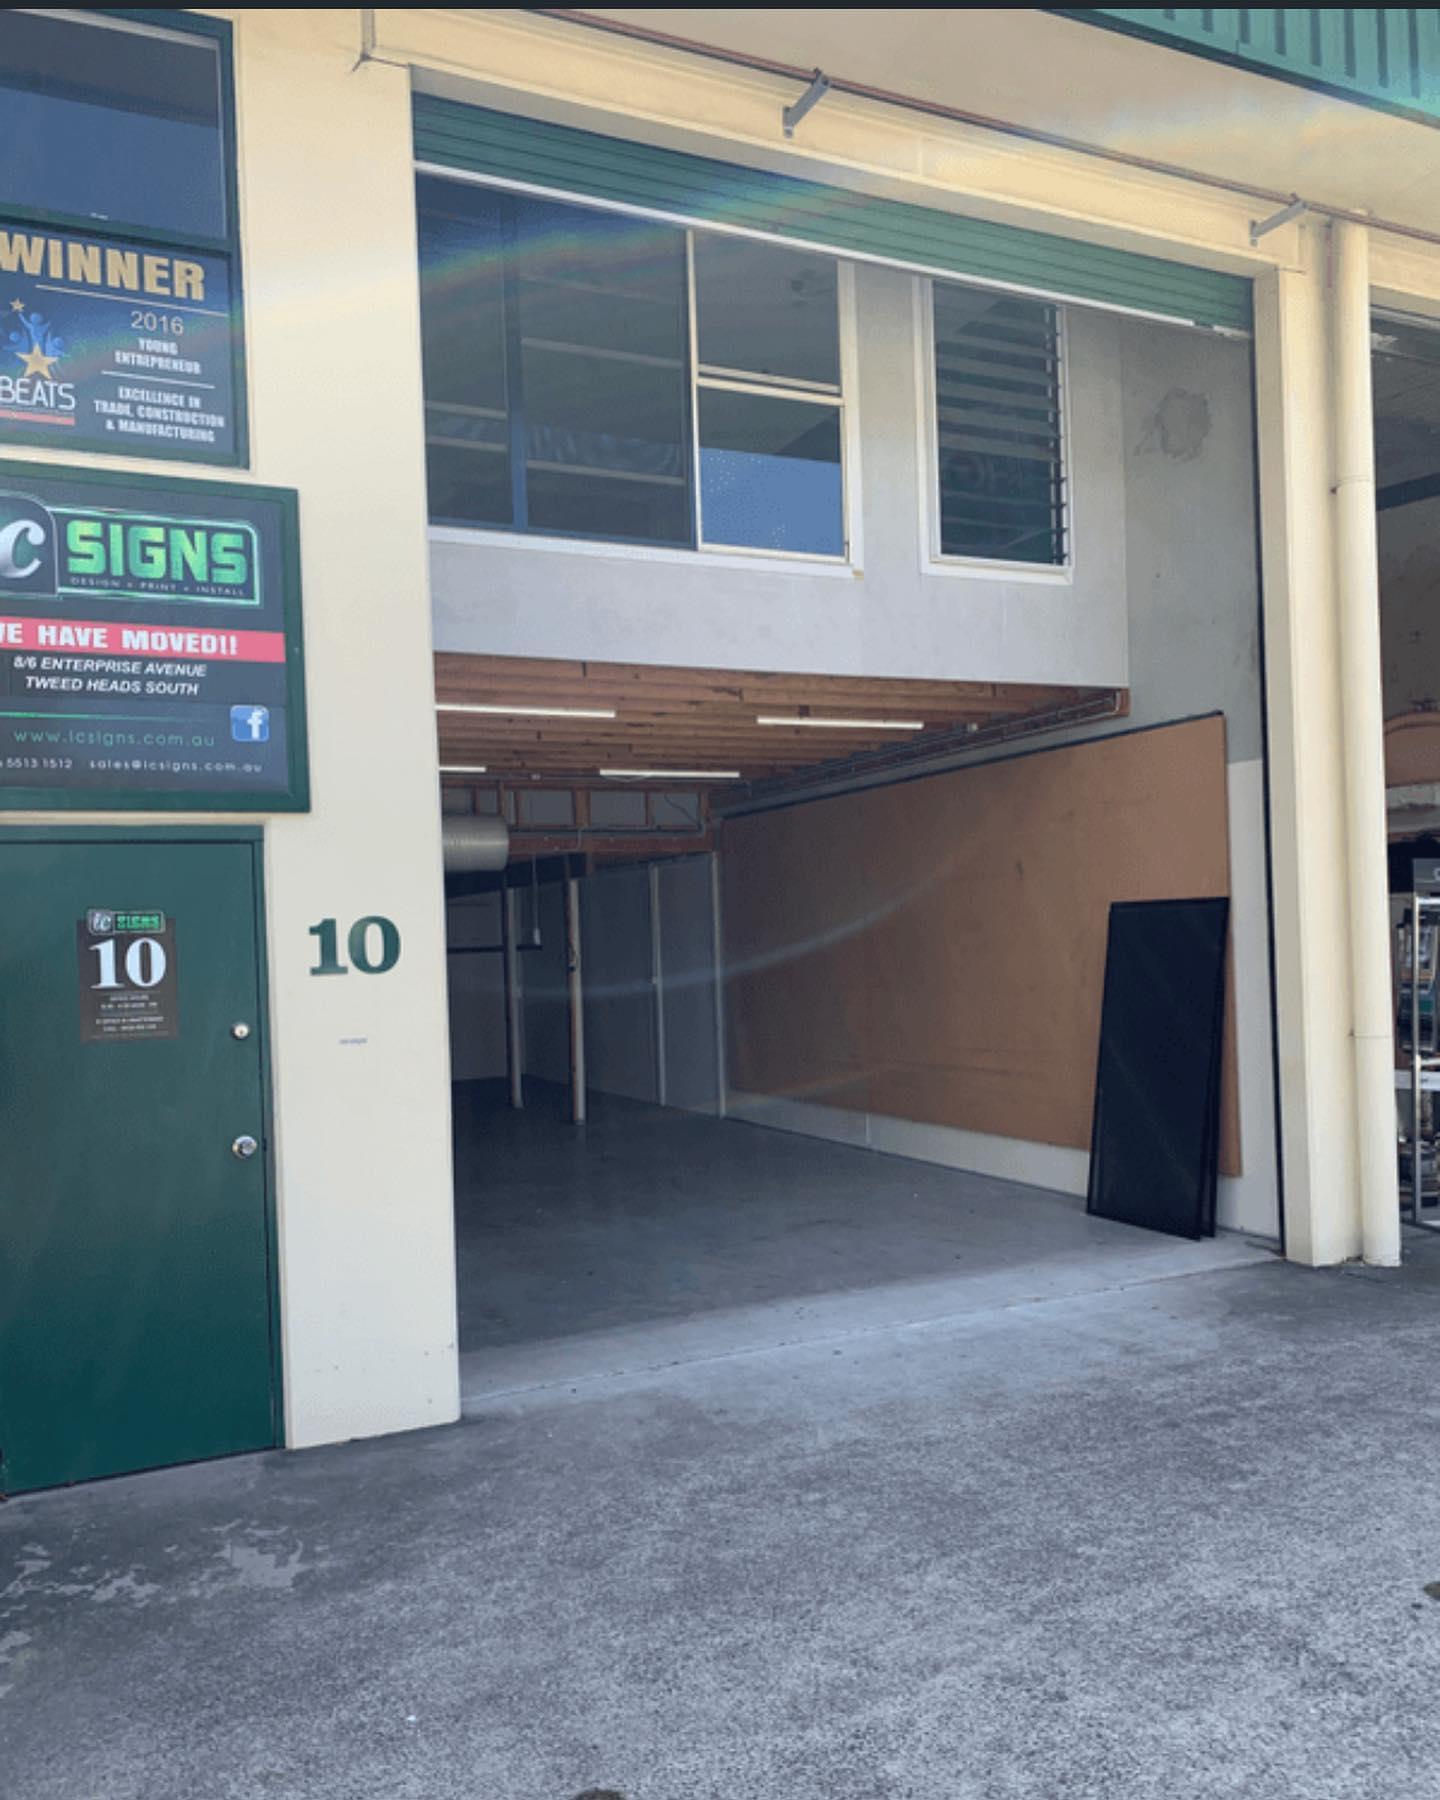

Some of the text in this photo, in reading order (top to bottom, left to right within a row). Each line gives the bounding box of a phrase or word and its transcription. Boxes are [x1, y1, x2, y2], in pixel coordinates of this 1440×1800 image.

[0, 231, 205, 300] WINNER
[131, 310, 184, 336] 2016
[138, 337, 178, 355] YOUNG
[115, 350, 201, 375] ENTREPRENEUR
[0, 375, 76, 411] BEATS
[118, 386, 201, 409] EXCELLENCE IN
[136, 405, 224, 428] CONSTRUCTION
[105, 419, 215, 442] & MANUFACTURING
[66, 519, 247, 584] SIGNS
[70, 577, 245, 597] DESIGN PRINT INSTALL
[38, 624, 108, 648] HAVE
[122, 629, 237, 655] MOVED!!
[14, 656, 207, 677] 8/6 ENTERPRISE AVENUE
[26, 676, 199, 695] TWEED HEADS SOUTH
[309, 915, 401, 976] 10
[89, 937, 166, 989] 10
